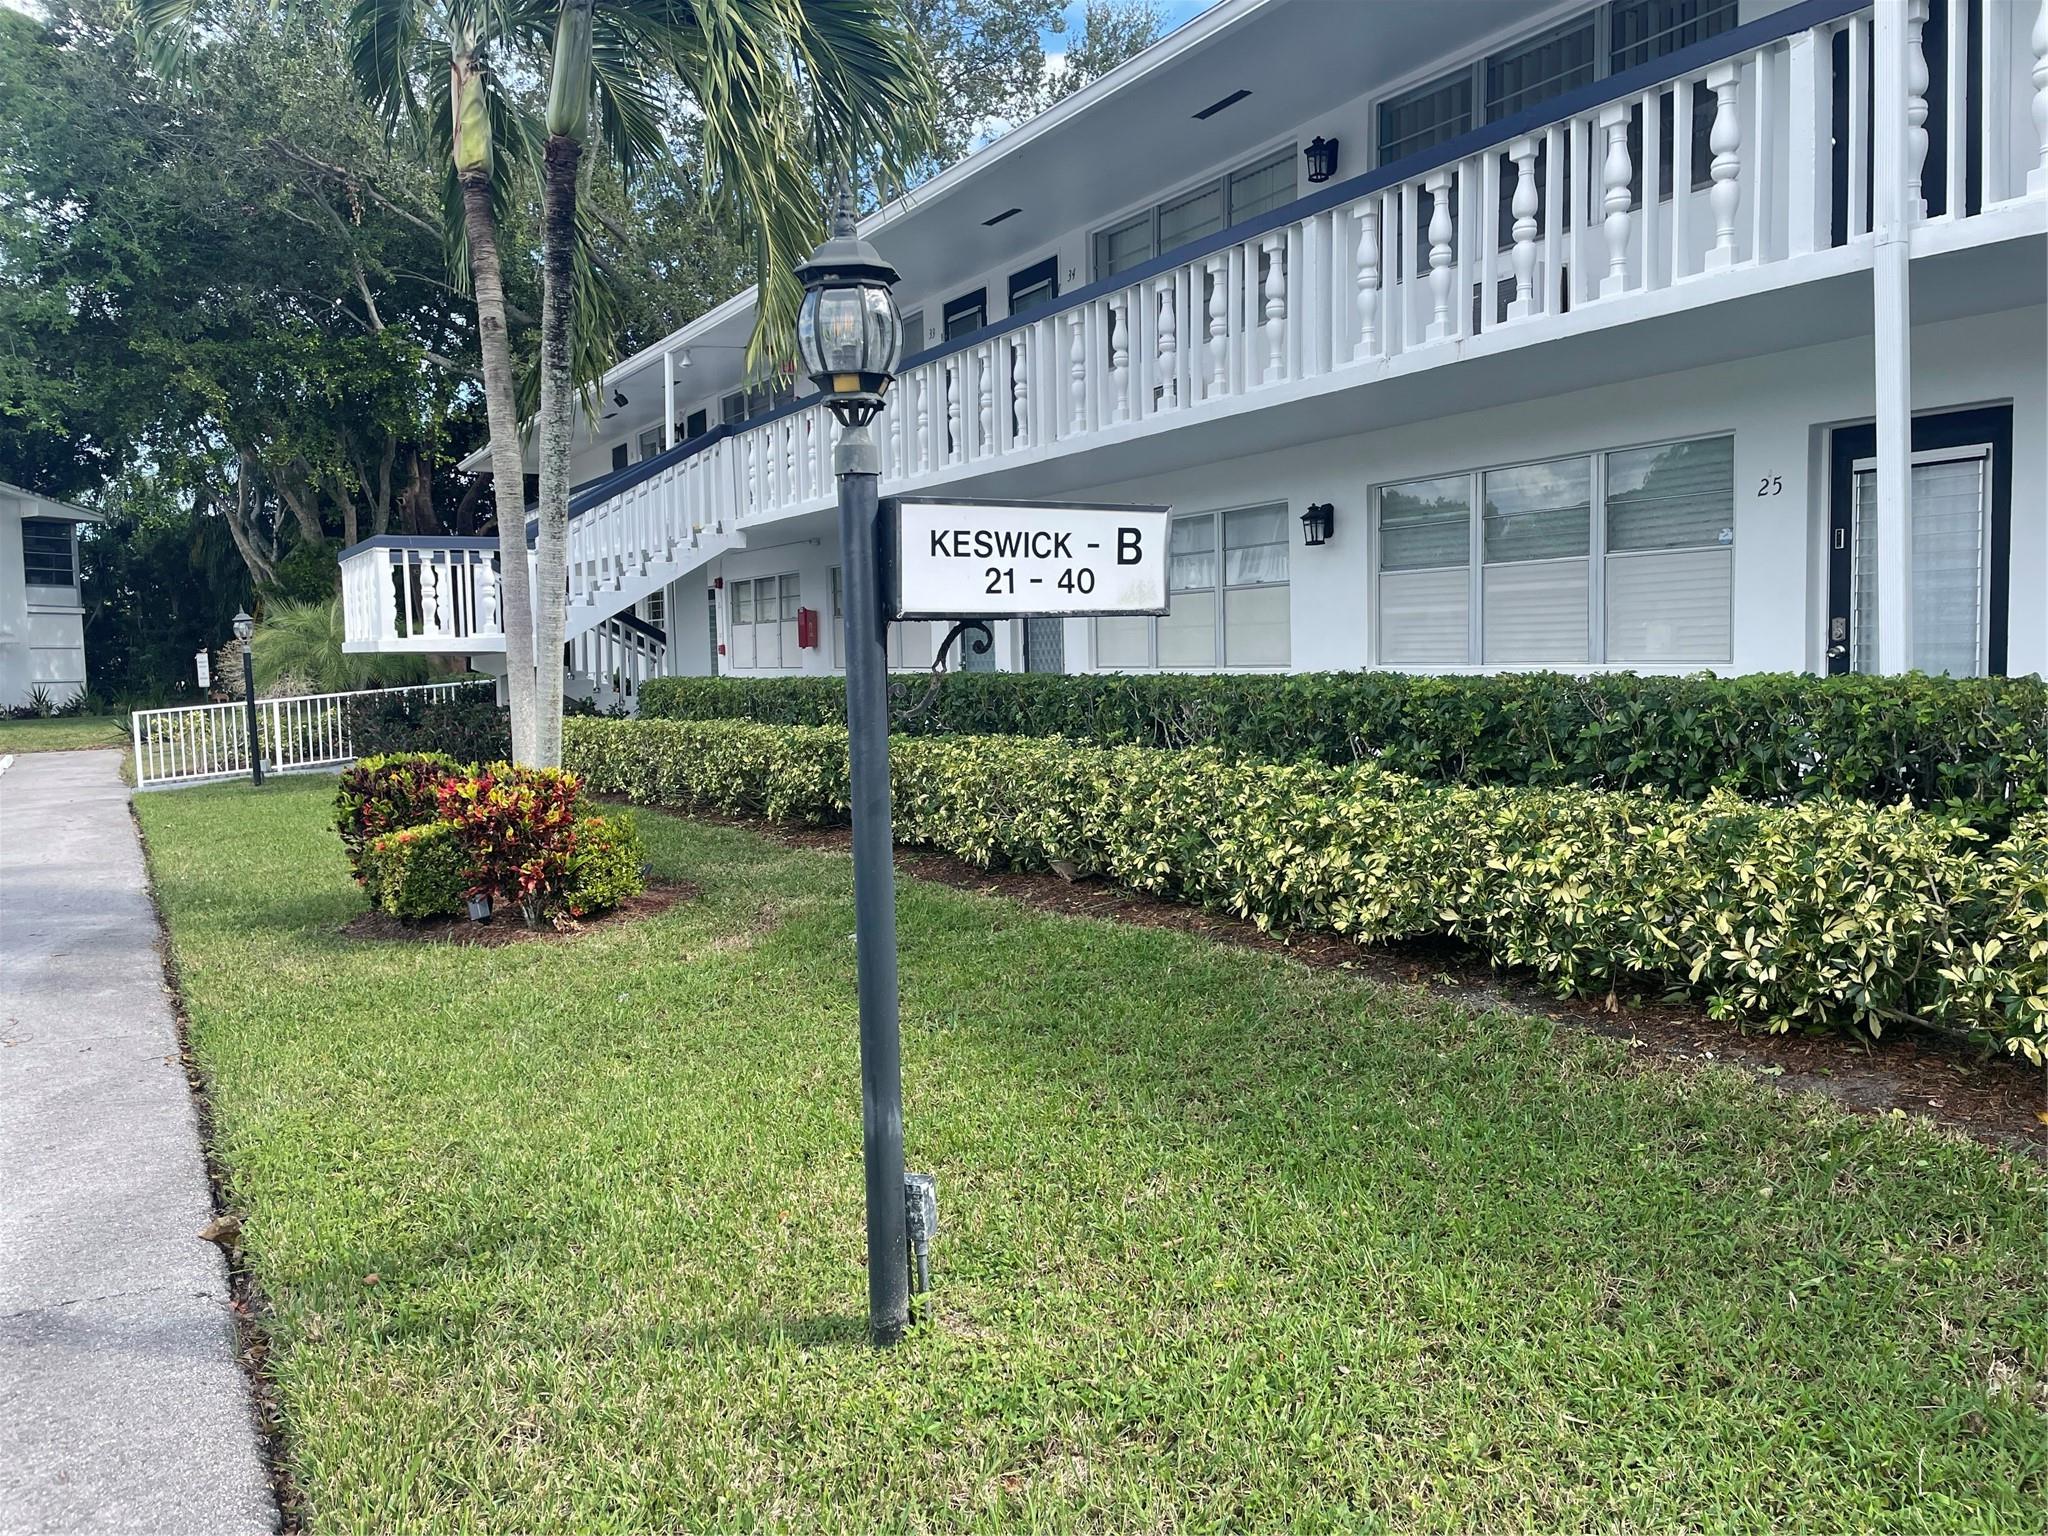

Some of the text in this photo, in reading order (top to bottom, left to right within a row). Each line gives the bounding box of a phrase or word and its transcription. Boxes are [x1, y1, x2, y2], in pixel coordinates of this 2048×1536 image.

[1757, 475, 1783, 497] 25
[930, 529, 1073, 559] KESWICK
[1116, 527, 1143, 565] B
[984, 567, 1015, 594] 21
[1057, 567, 1095, 594] 40
